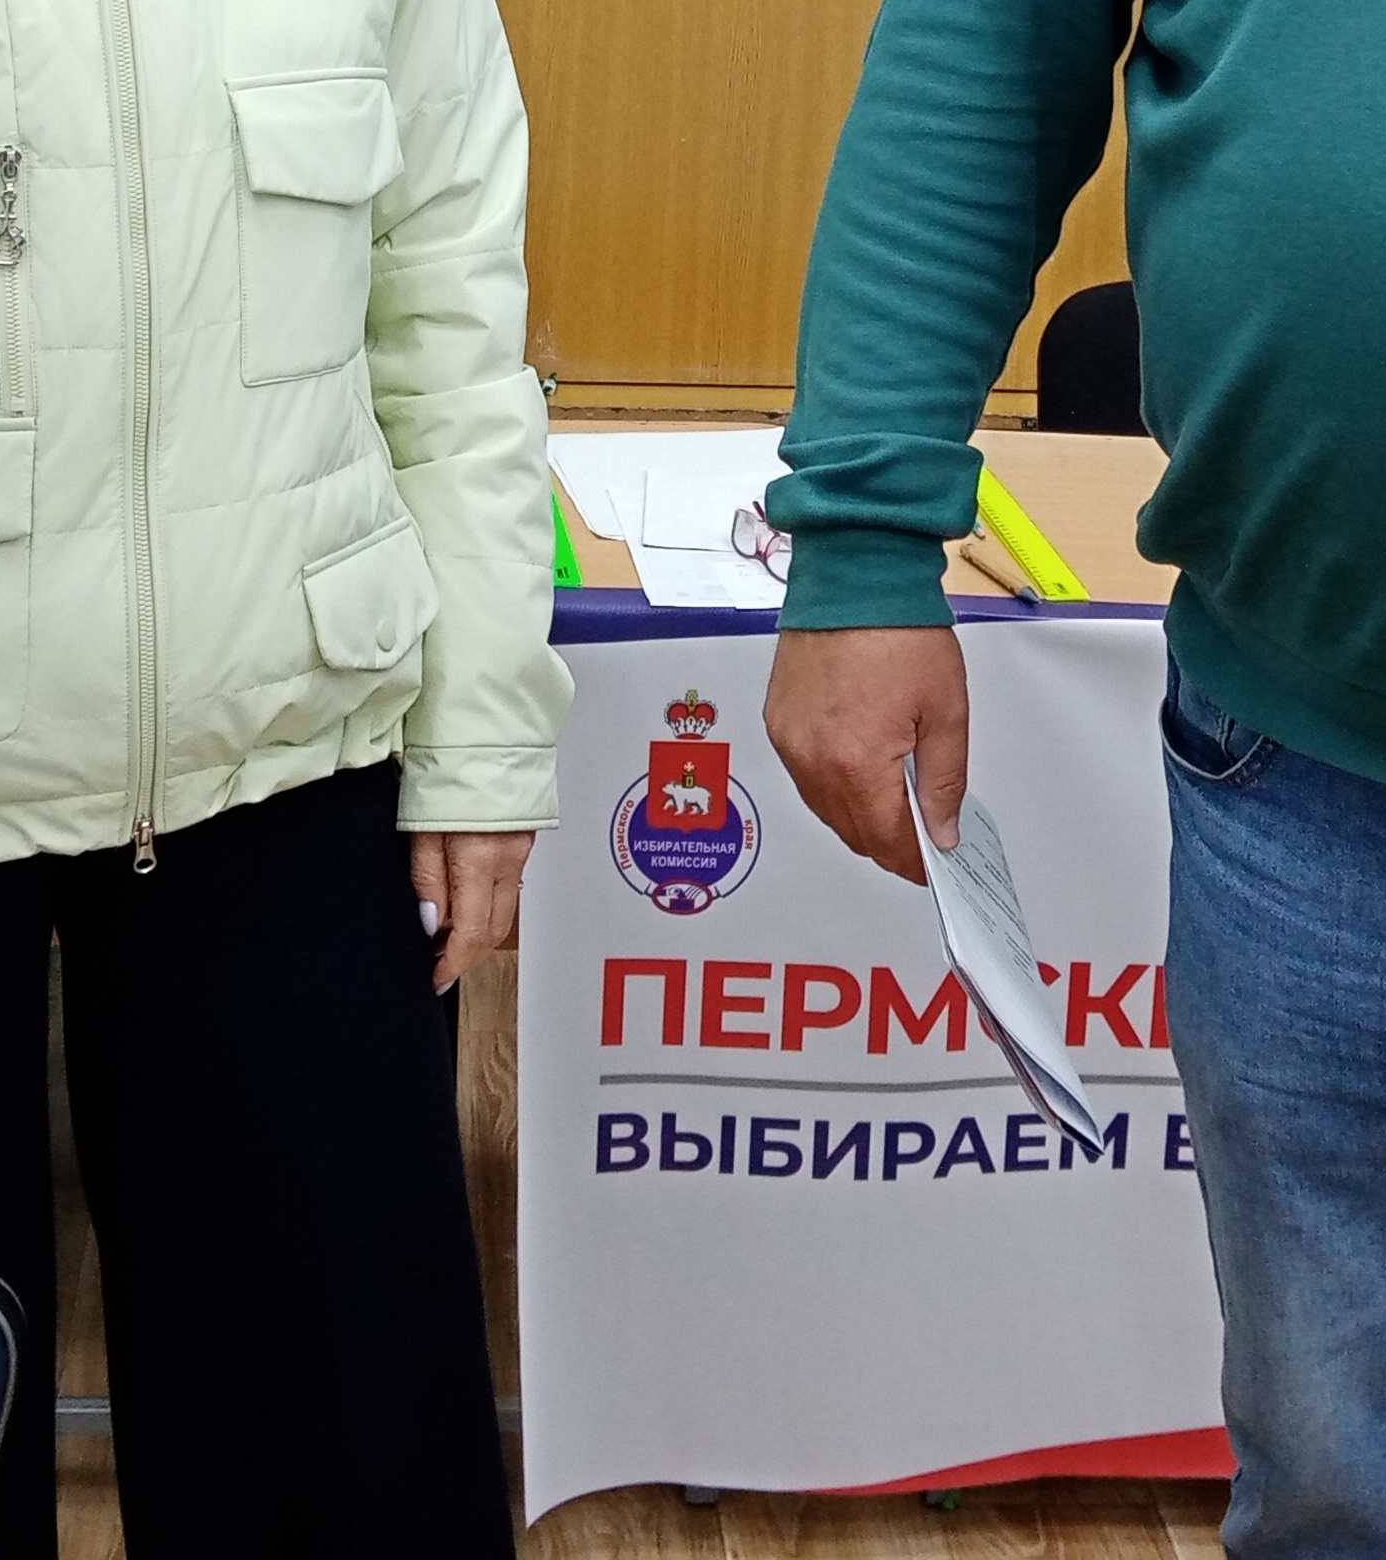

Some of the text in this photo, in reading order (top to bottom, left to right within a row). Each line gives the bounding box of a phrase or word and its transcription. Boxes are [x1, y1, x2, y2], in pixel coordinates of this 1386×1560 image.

[616, 799, 755, 871] Пермского края
[632, 839, 737, 855] ИЗБИРАТЕЛЬНАЯ
[650, 856, 718, 870] КОМИССИЯ
[600, 958, 1173, 1055] ПЕРМК
[595, 1111, 1130, 1182] ВЫБИРАЕМ
